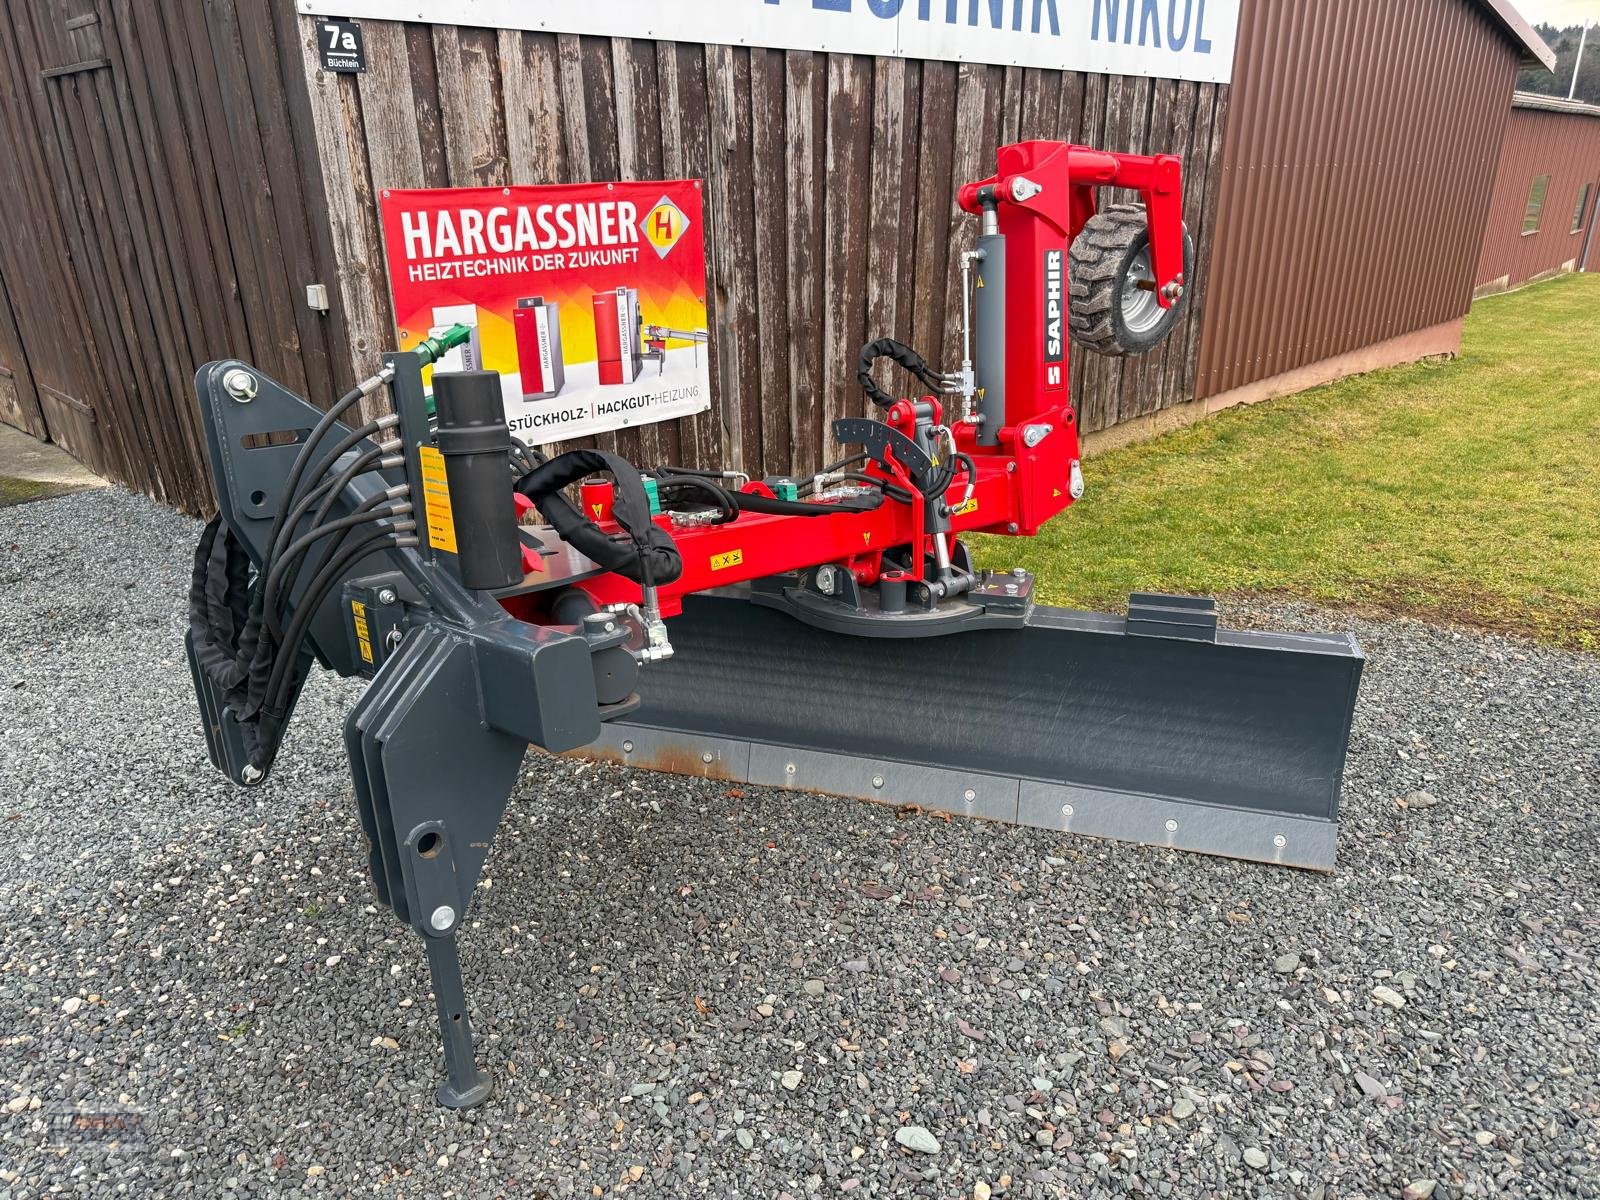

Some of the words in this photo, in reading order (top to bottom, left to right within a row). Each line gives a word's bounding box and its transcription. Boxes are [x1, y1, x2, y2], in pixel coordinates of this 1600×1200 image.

[324, 25, 357, 50] 7a
[327, 58, 359, 68] Büchlein
[401, 201, 638, 260] HARGASSNER
[409, 256, 529, 282] HEIZTECHNIK
[532, 252, 565, 272] DER
[570, 247, 639, 268] ZUKUNFT
[1047, 251, 1060, 356] SAPHIR
[509, 407, 588, 431] STÜCKHOLZ-
